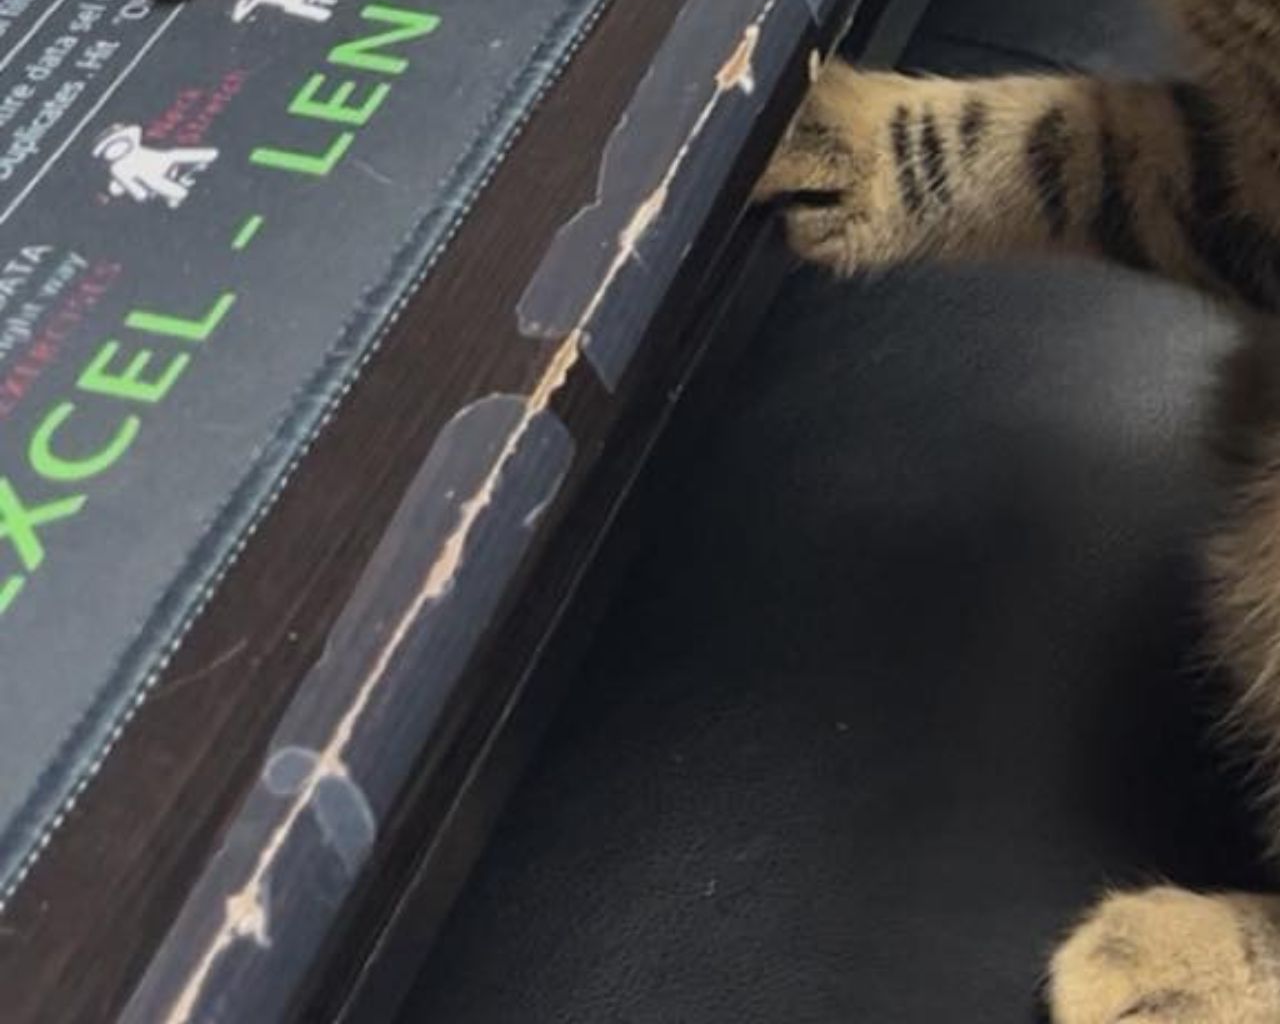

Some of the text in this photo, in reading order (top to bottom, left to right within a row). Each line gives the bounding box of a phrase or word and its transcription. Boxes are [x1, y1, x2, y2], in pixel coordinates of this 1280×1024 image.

[25, 36, 79, 80] data
[0, 245, 53, 310] ATA
[0, 293, 236, 614] XCEL
